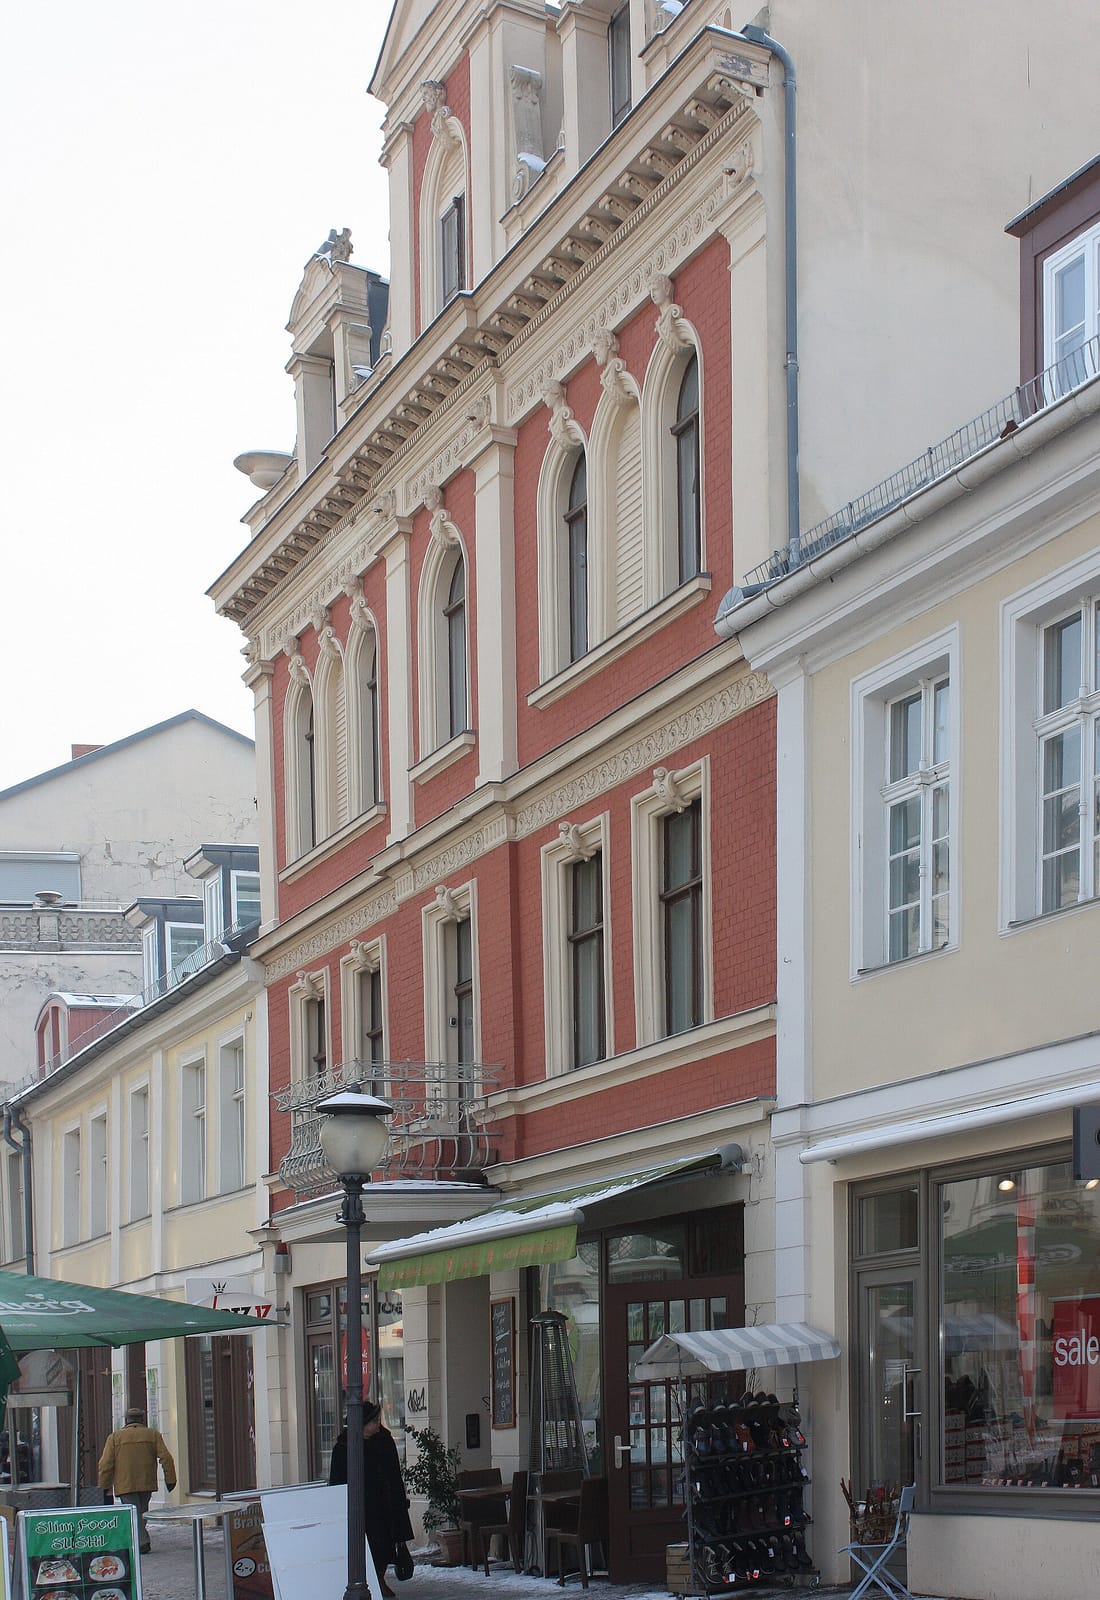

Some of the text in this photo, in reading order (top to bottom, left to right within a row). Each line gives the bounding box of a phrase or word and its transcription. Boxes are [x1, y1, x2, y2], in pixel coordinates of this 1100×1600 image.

[255, 1305, 272, 1318] 17
[1054, 1328, 1099, 1366] sale
[35, 1515, 119, 1535] Slim Food
[234, 1516, 264, 1529] Brat
[51, 1534, 107, 1550] SUSHI
